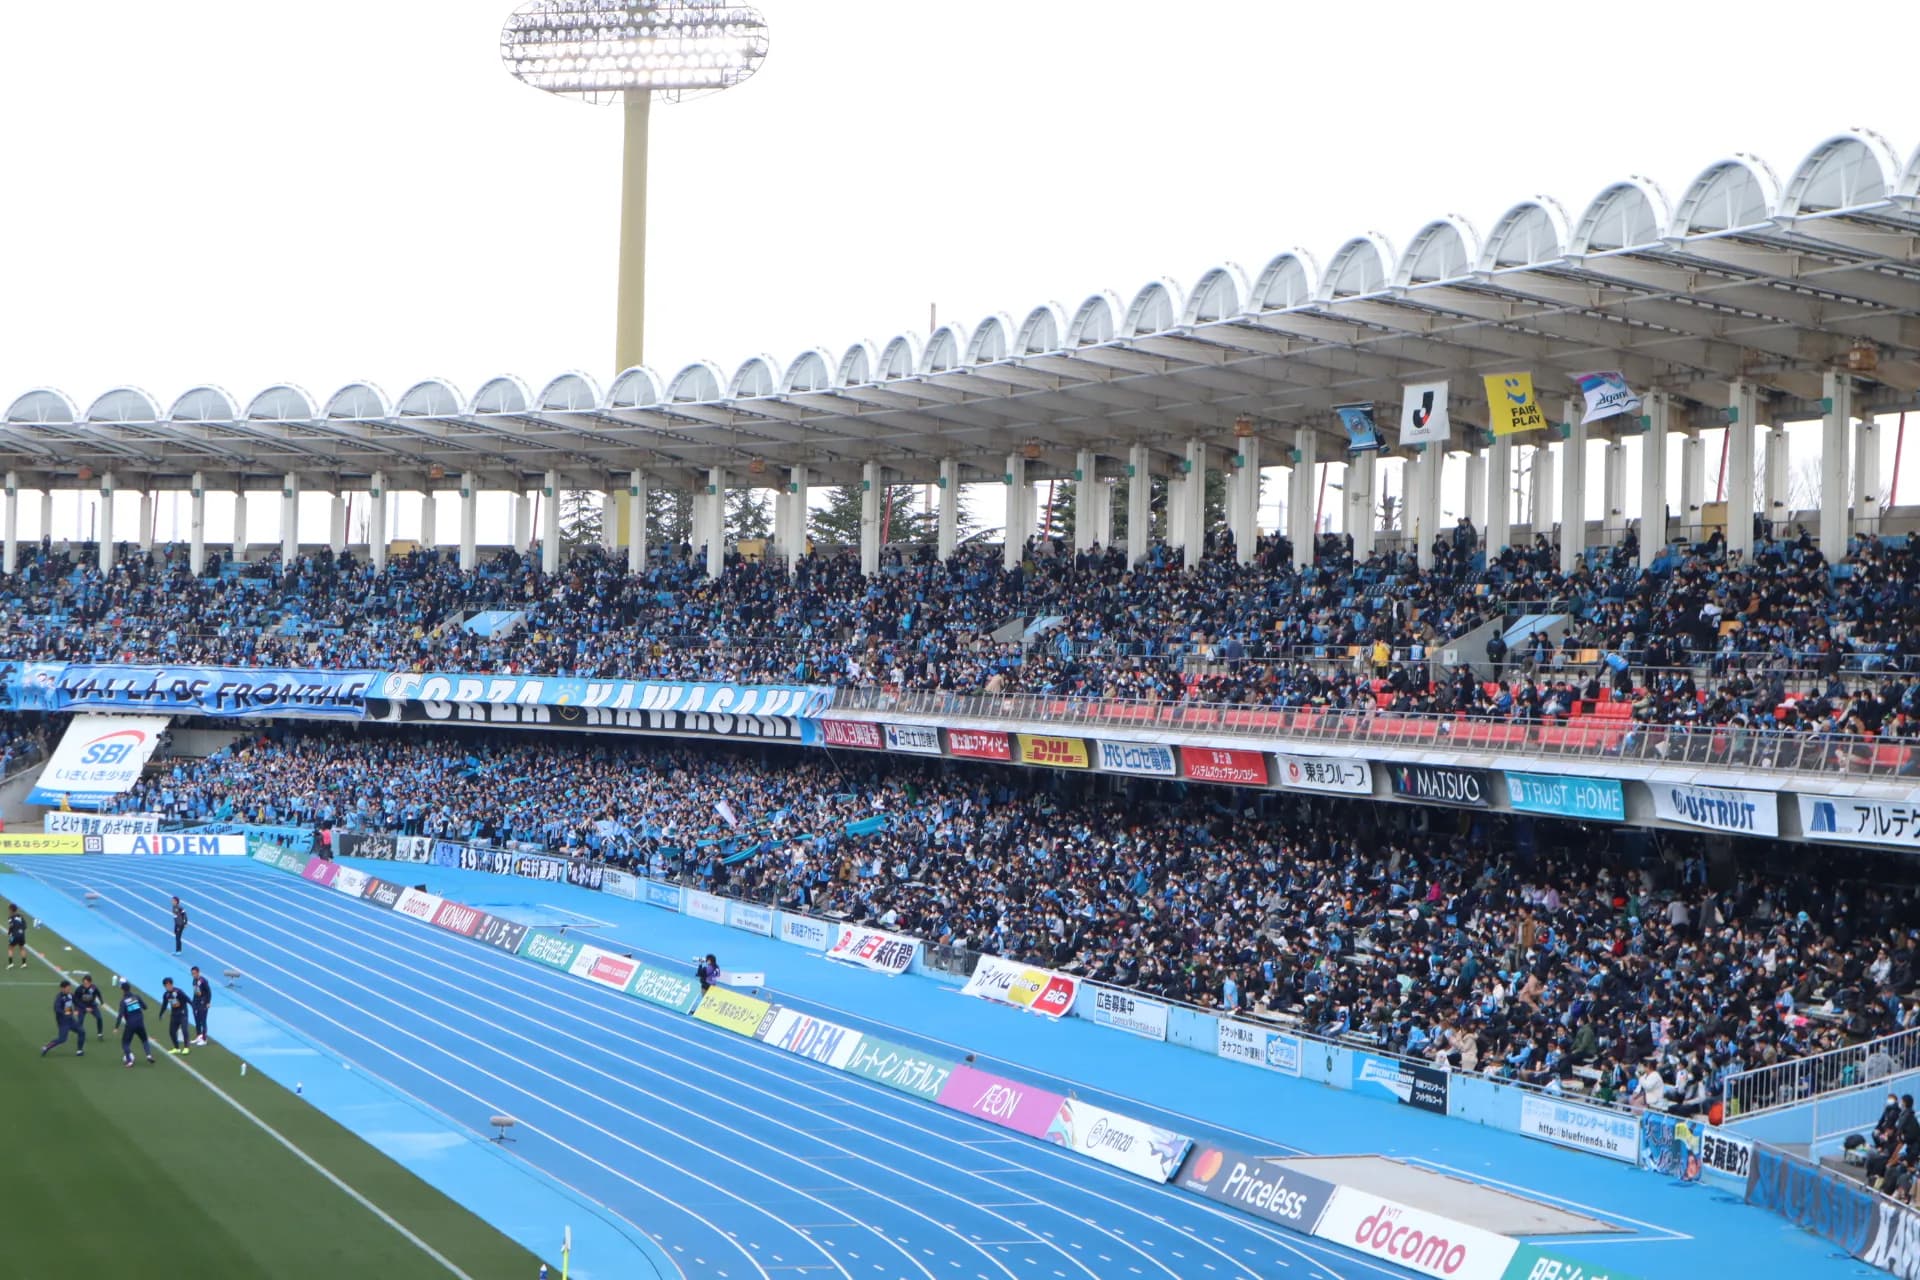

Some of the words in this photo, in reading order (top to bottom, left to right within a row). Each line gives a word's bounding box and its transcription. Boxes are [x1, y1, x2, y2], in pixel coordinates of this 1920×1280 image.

[1511, 404, 1537, 418] FAIR
[1511, 414, 1541, 428] PLAY
[216, 682, 367, 709] FRONTALE
[383, 672, 550, 722] FORZA
[581, 683, 806, 737] KAWASAKI
[81, 743, 134, 764] SBI
[1031, 738, 1075, 764] DHL
[1304, 761, 1366, 786] 東急グループ
[1417, 771, 1480, 801] MATSUO
[1524, 781, 1569, 806] TRUST
[1576, 784, 1621, 811] HOME
[849, 935, 914, 969] 朝日新聞
[1096, 992, 1135, 1015] 広告募集中
[1355, 1205, 1466, 1275] docomo
